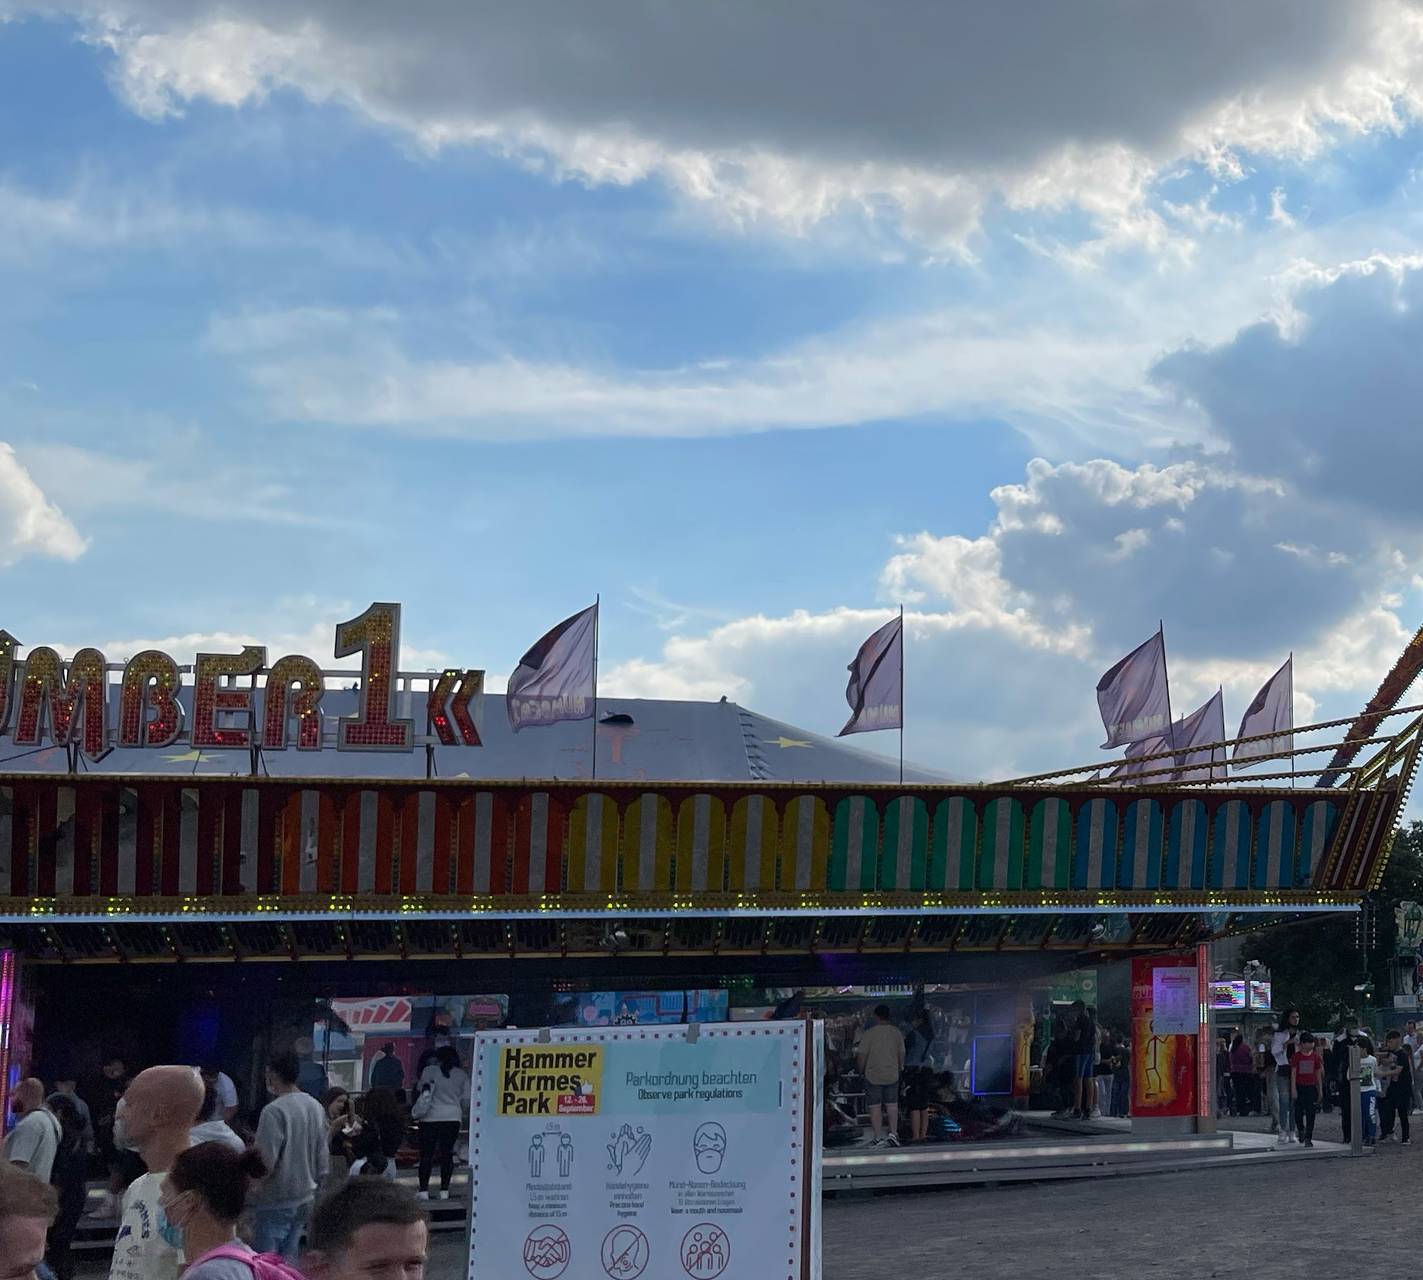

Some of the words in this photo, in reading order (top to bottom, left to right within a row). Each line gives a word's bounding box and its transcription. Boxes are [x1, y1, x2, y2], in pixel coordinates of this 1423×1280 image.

[504, 1047, 598, 1070] Hammer
[503, 1070, 582, 1093] Kirmes
[626, 1070, 700, 1087] Parkordnung
[702, 1069, 758, 1086] beachten
[502, 1092, 550, 1115] Park
[638, 1088, 673, 1101] Observe
[673, 1089, 695, 1102] park
[695, 1086, 744, 1101] regulations
